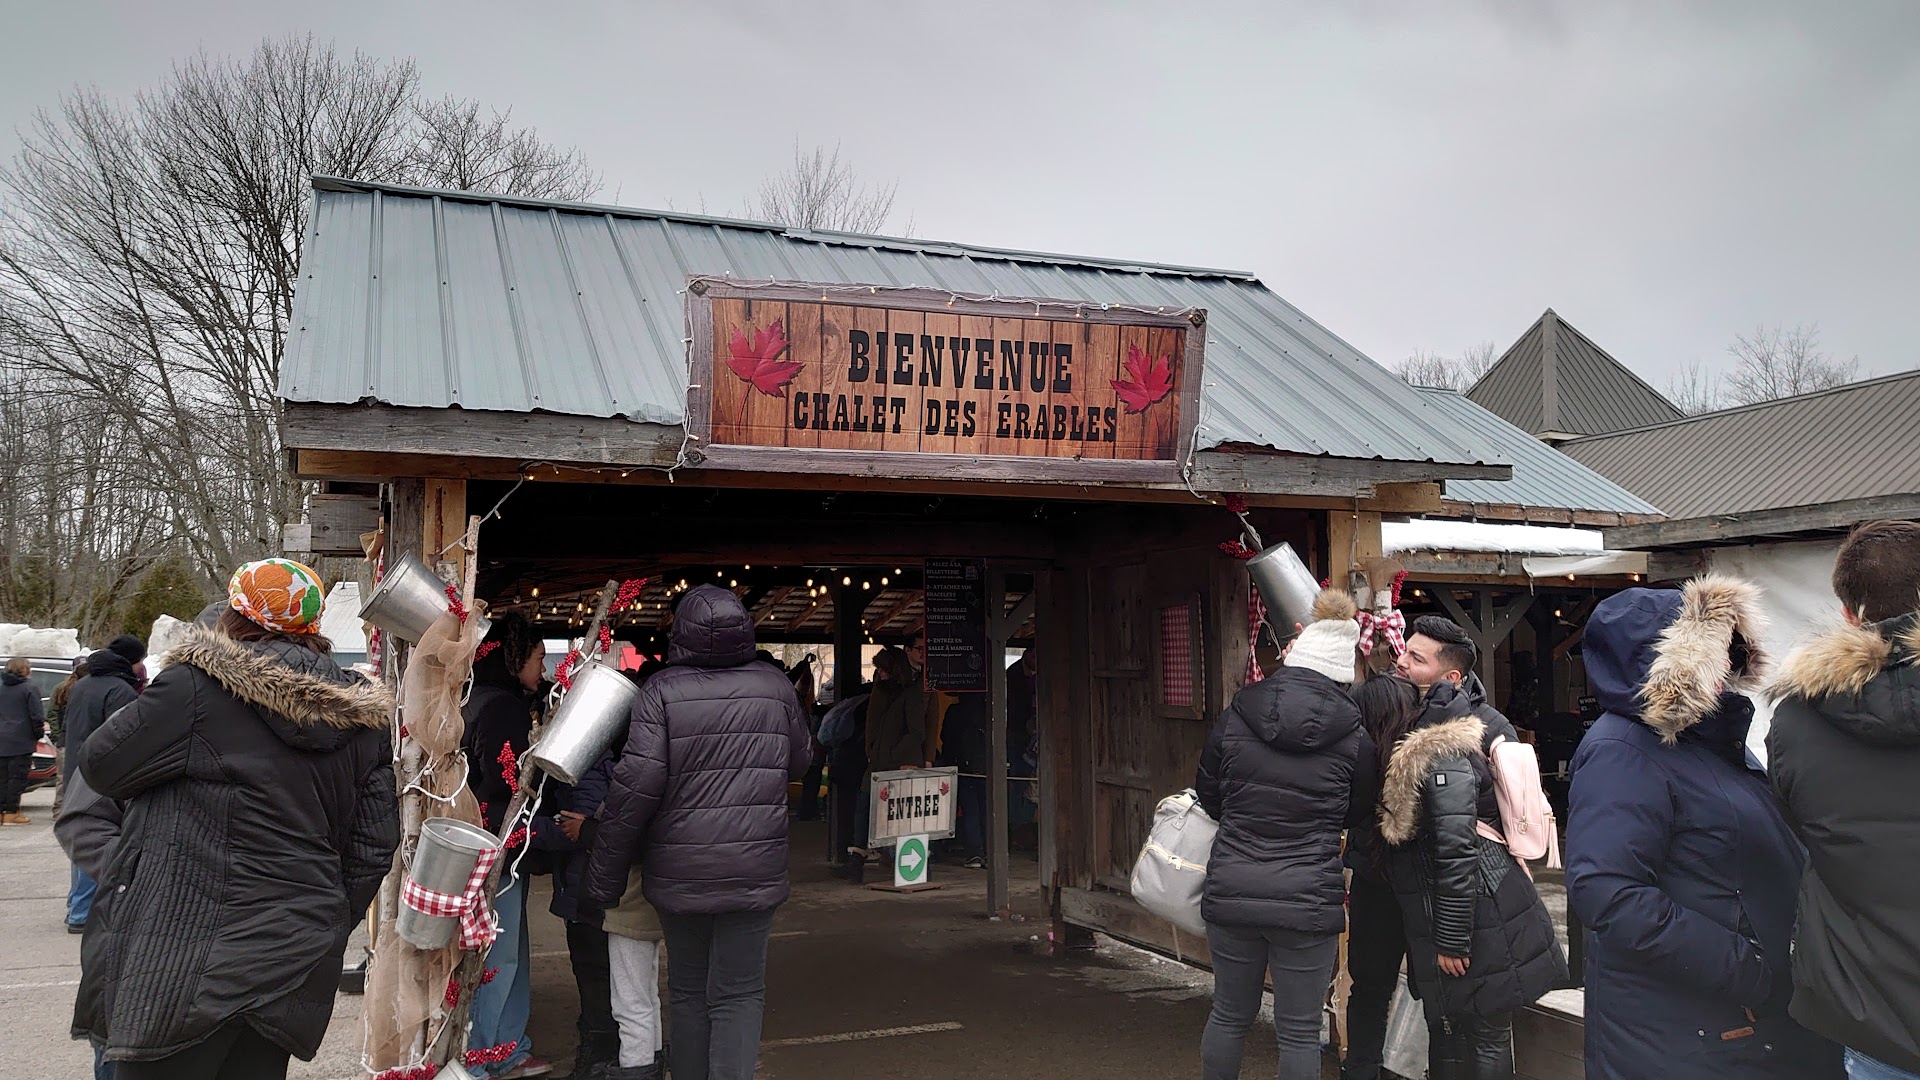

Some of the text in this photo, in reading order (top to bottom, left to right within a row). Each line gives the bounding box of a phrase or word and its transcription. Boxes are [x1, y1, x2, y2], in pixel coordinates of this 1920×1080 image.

[848, 329, 1073, 394] BIENVENUE
[793, 391, 1117, 442] CHALET DES ÉRABLES
[887, 790, 939, 820] ENTRÉE
